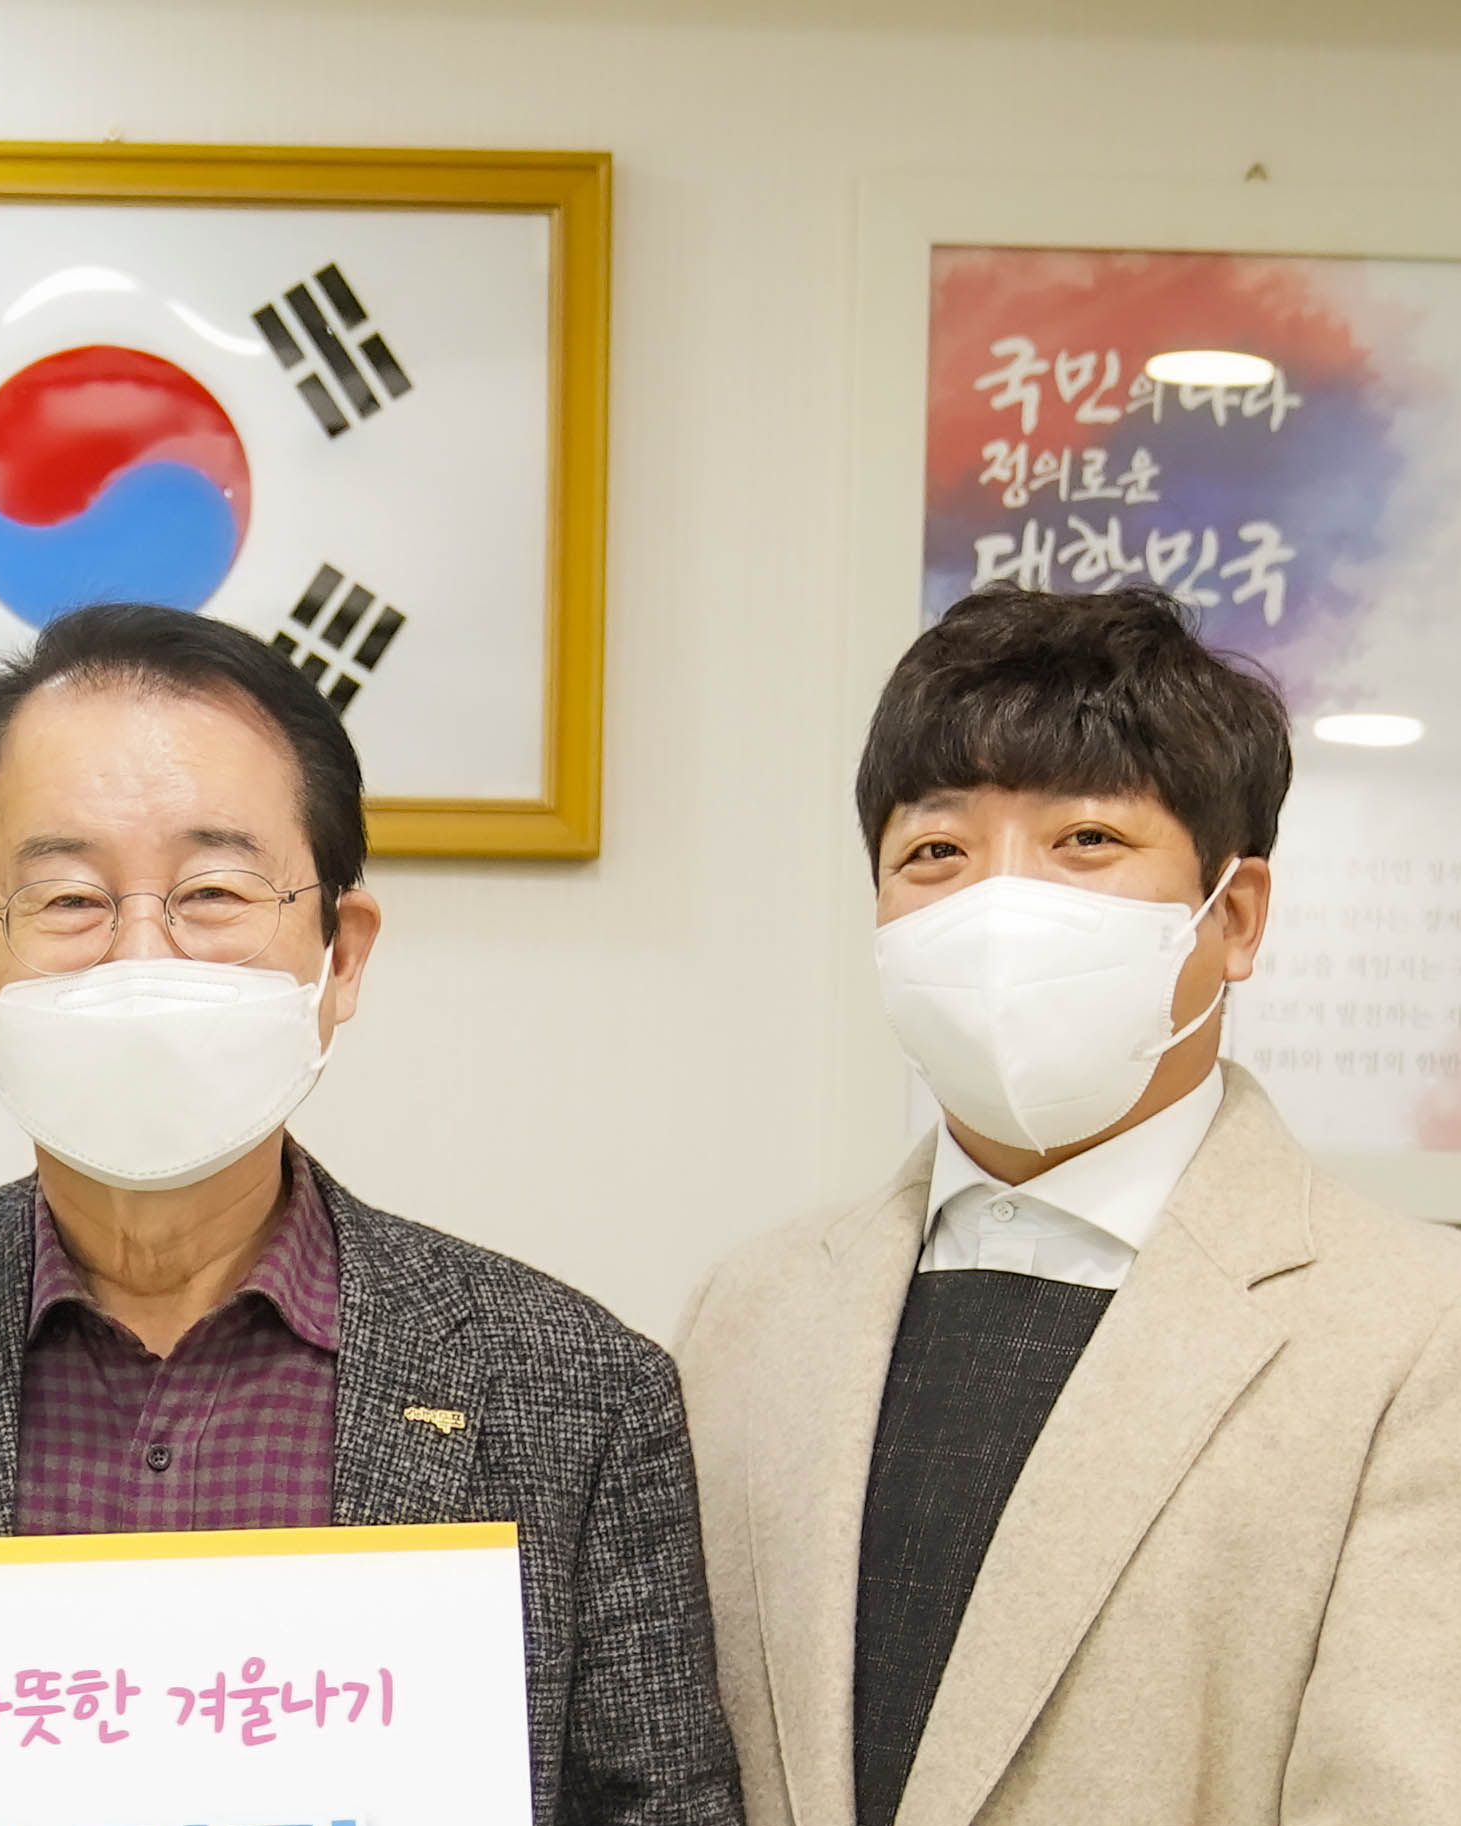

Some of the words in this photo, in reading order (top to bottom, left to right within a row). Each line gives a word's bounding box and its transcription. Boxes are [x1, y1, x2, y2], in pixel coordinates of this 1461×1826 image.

[974, 336, 1164, 435] 국민의
[979, 439, 1160, 508] 정의로운
[971, 515, 1297, 626] 대한민국
[167, 1657, 393, 1747] 겨울나기
